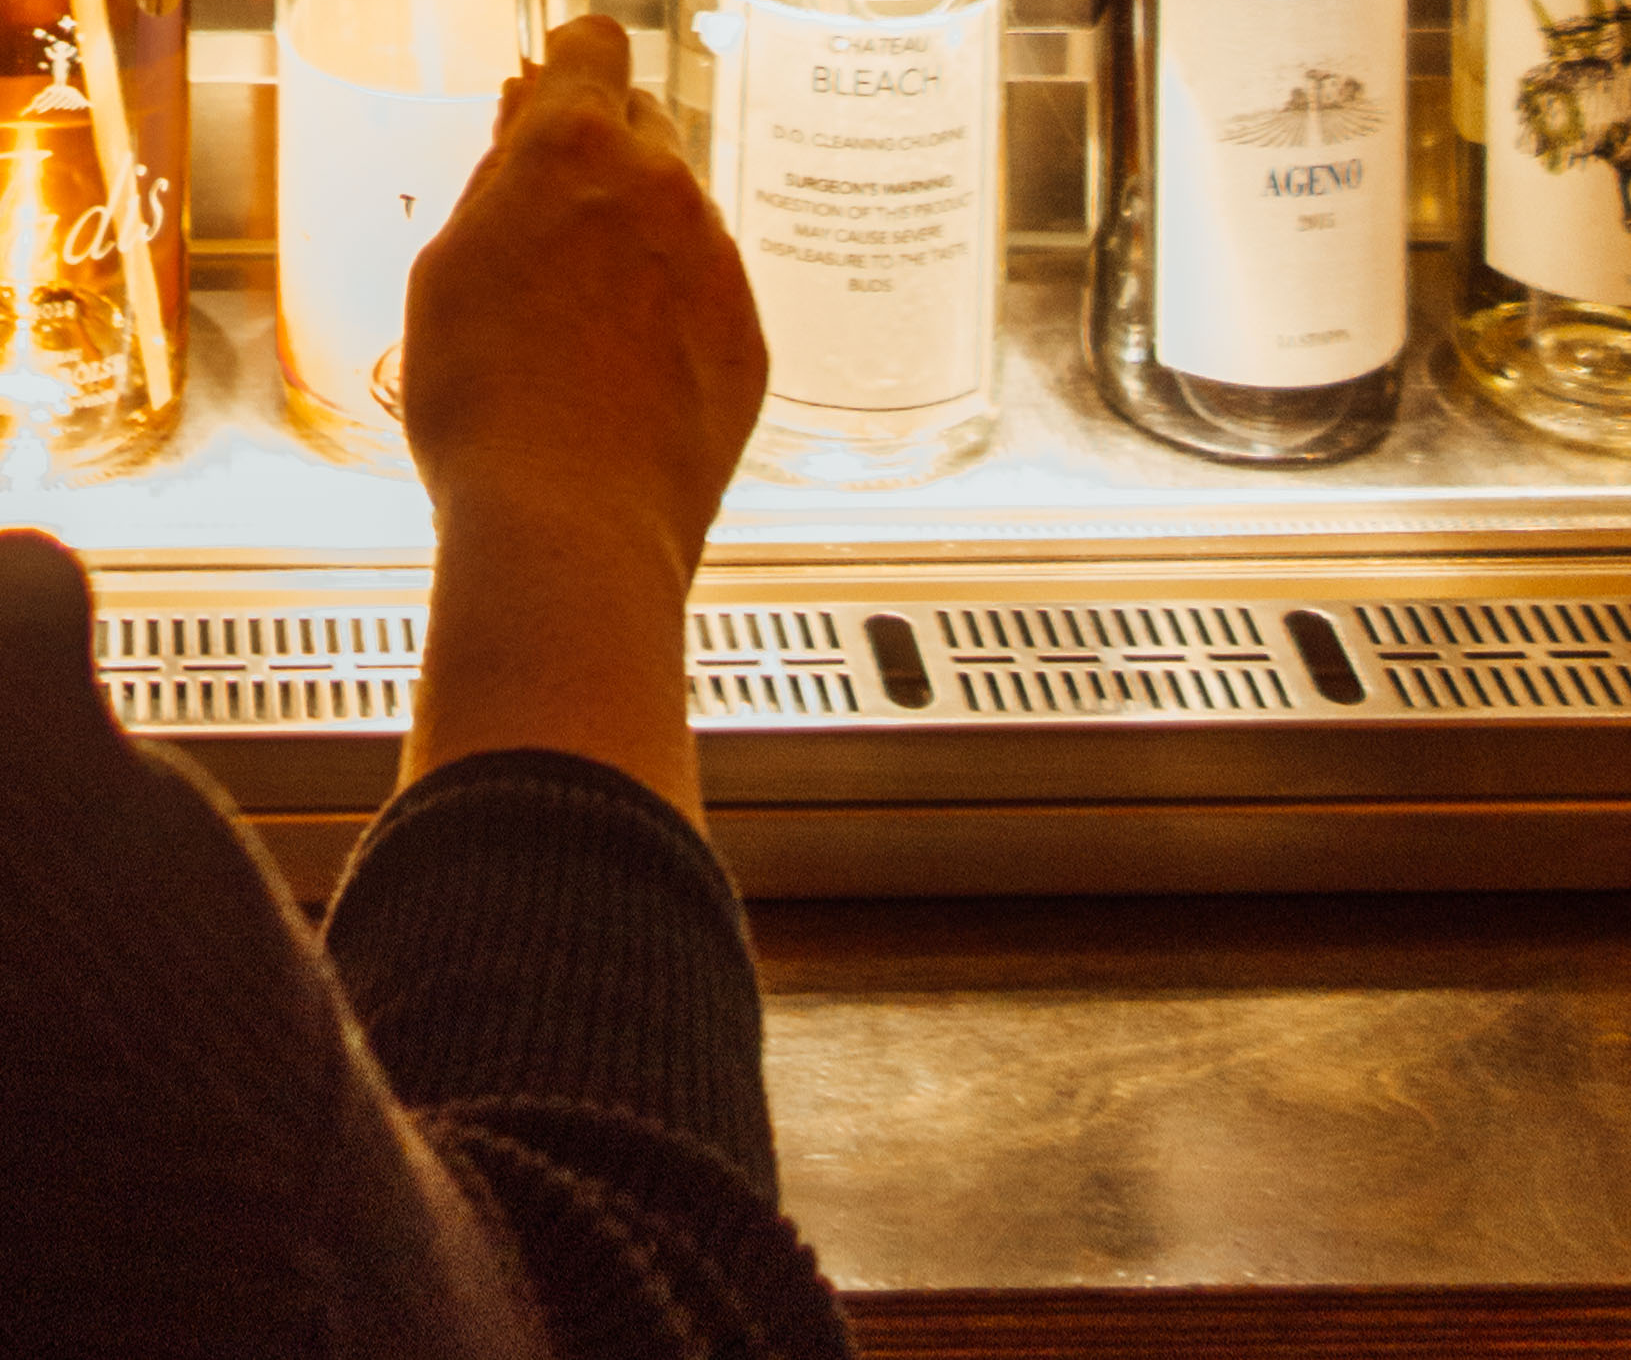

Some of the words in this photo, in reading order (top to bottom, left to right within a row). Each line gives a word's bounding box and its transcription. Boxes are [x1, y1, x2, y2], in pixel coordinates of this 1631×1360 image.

[830, 36, 928, 54] CHATEAU
[811, 66, 940, 96] BLEACH
[813, 133, 895, 150] CLEANING
[785, 172, 879, 195] SURGEON'S
[1262, 157, 1368, 196] AGENO
[756, 189, 841, 216] INGESTION
[848, 206, 868, 219] OF
[794, 224, 829, 238] MAY
[835, 228, 885, 244] CAUSE
[891, 224, 943, 244] SEVERE
[760, 238, 864, 267] DISPLEASURE
[872, 254, 893, 268] TO
[900, 252, 925, 266] THE
[848, 277, 893, 292] BUDS
